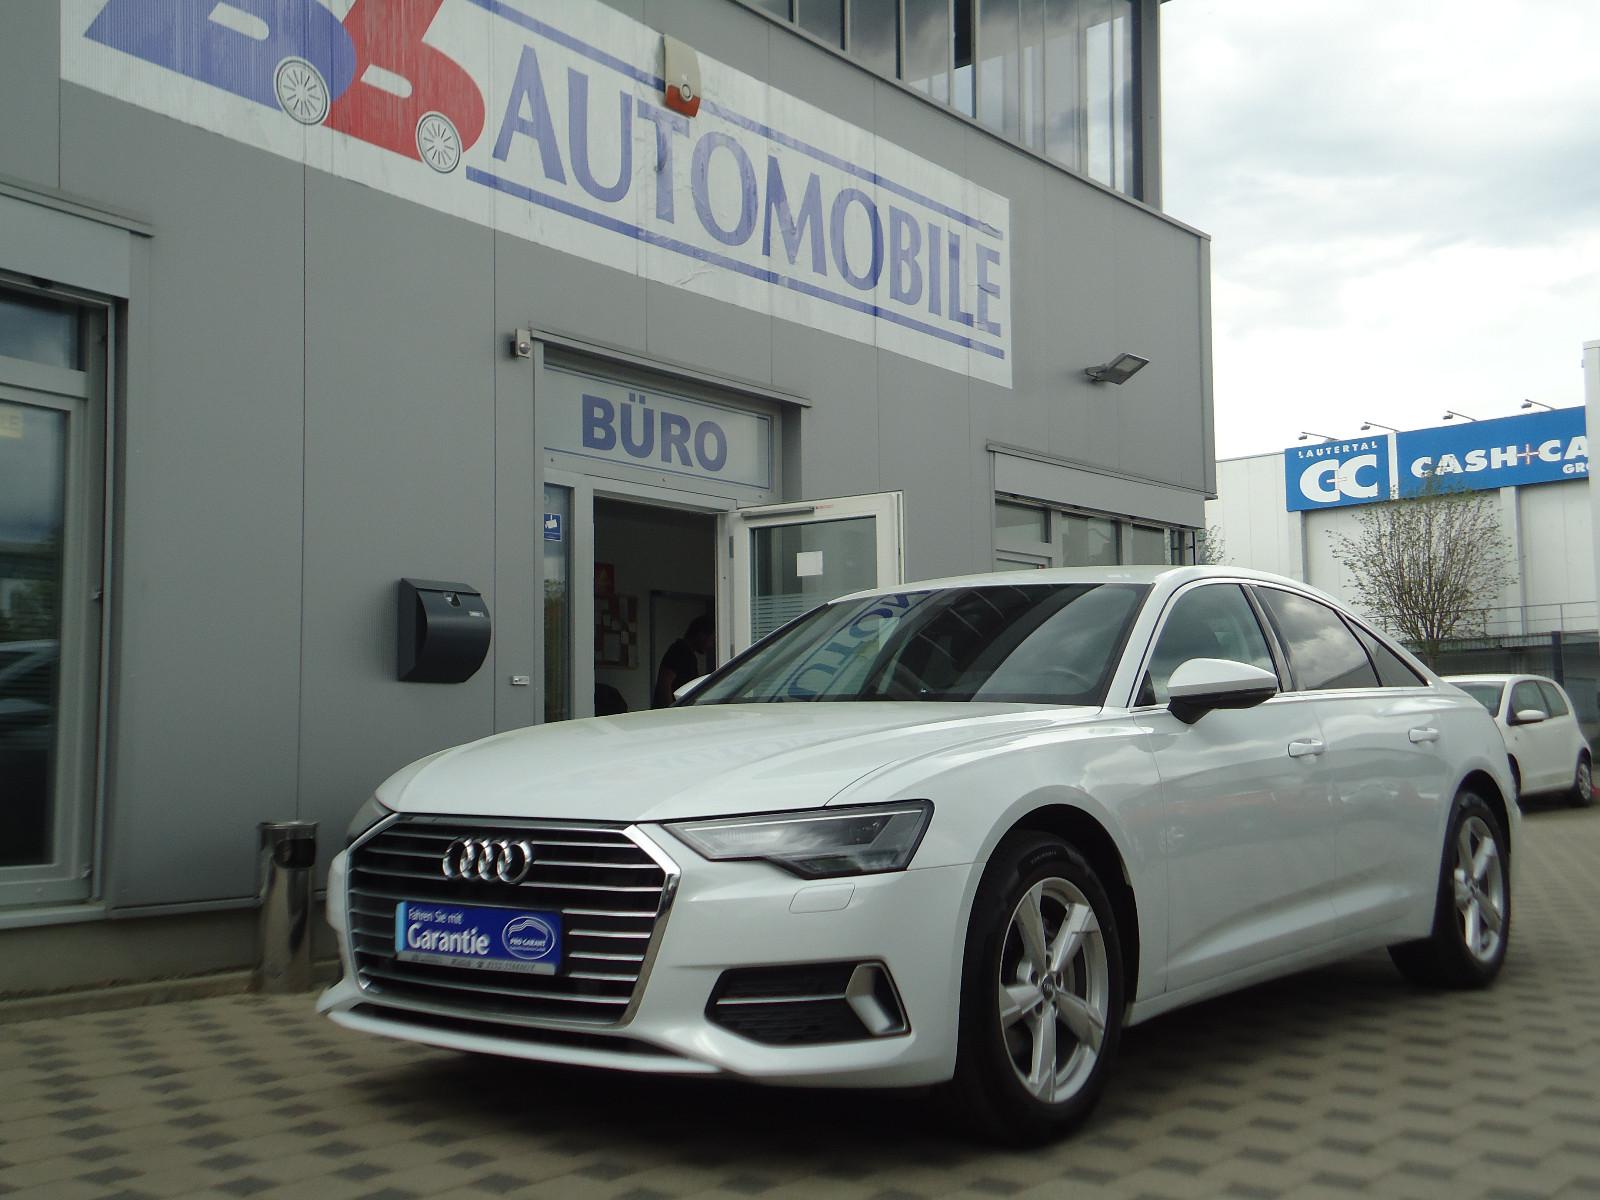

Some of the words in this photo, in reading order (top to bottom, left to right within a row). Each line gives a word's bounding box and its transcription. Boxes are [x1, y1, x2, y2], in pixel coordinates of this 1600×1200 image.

[492, 45, 1002, 337] AUTOMOBILE
[582, 393, 728, 472] BÜRO
[1298, 440, 1378, 459] LAUTERTAL
[408, 907, 433, 922] Fahren
[434, 909, 447, 924] Sie
[447, 911, 464, 925] mit
[407, 922, 490, 956] Garantie
